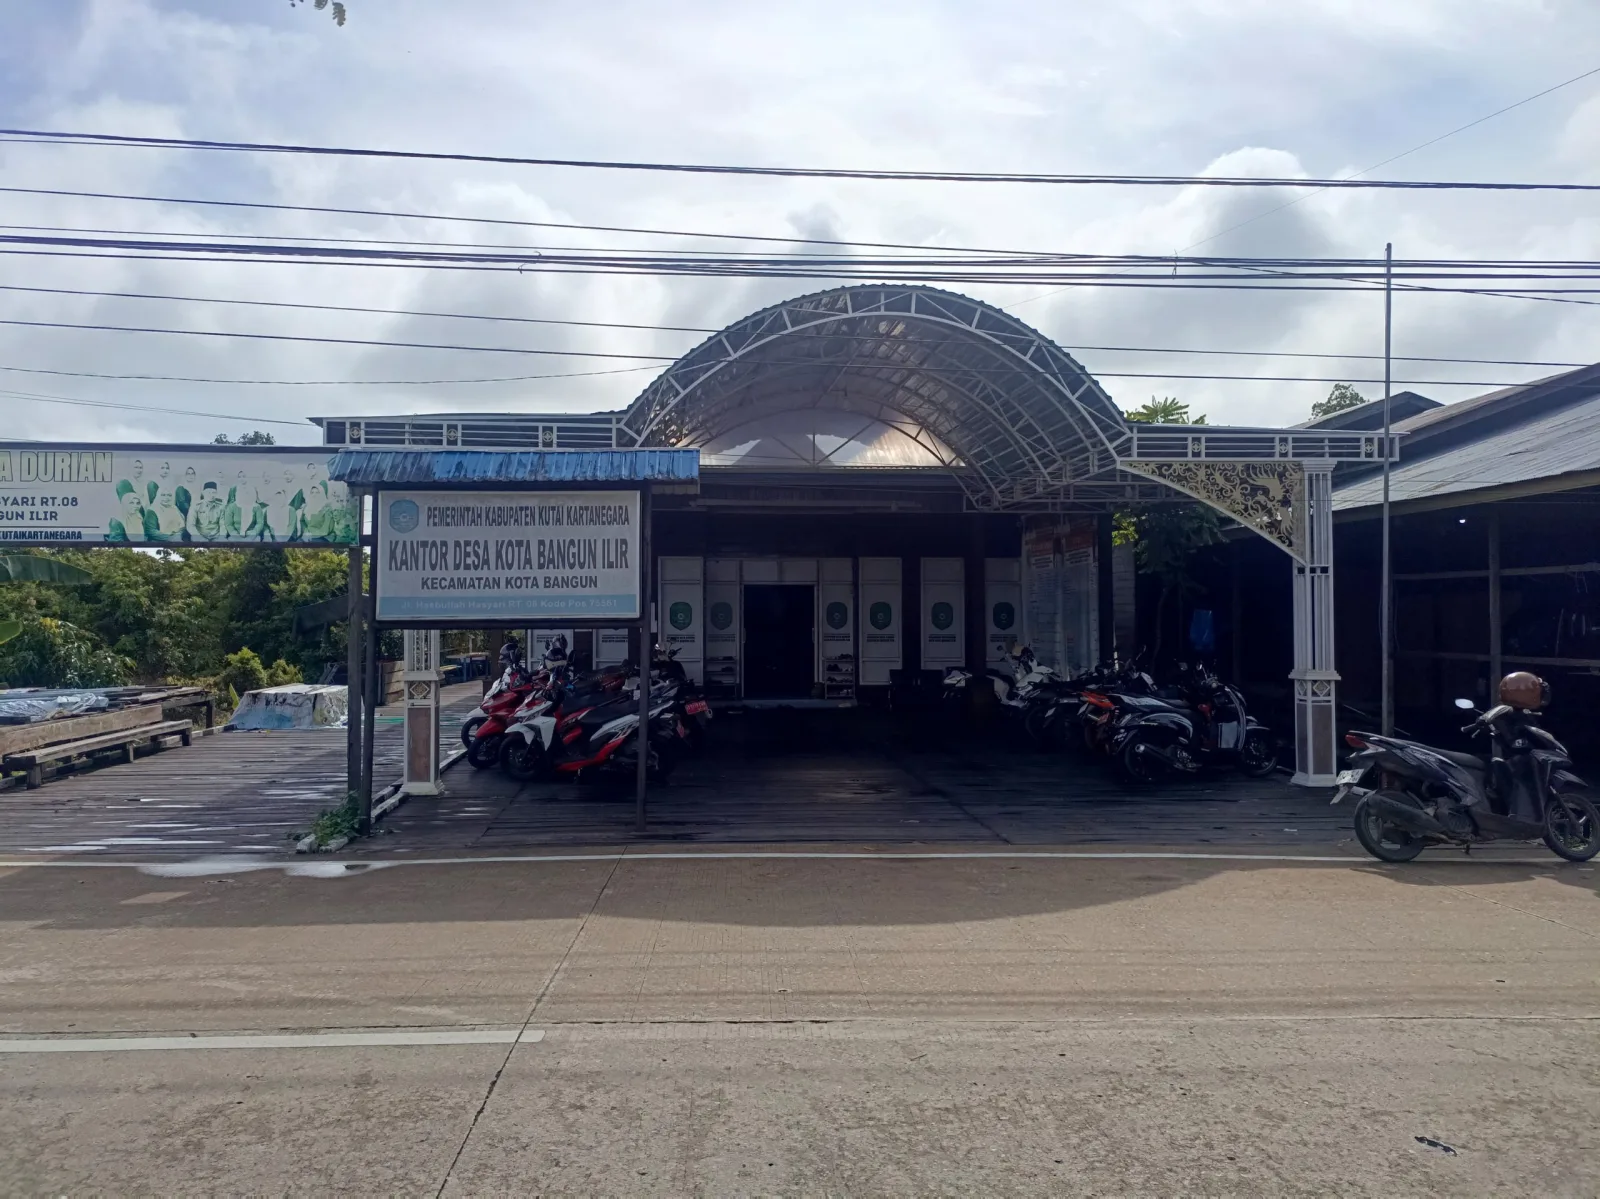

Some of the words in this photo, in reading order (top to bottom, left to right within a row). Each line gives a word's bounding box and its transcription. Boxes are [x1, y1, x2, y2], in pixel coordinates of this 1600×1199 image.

[20, 451, 113, 482] DURIAN
[0, 496, 36, 507] YARI
[40, 496, 78, 507] RT.08
[29, 511, 58, 521] ILIR
[426, 506, 482, 527] PEMERINTAH
[485, 506, 536, 527] KABUPATEN
[538, 506, 564, 526] KUTAI
[566, 505, 630, 526] KARTANEGARA
[0, 530, 82, 540] UTAIKARTANEGARA
[388, 540, 449, 571] KANTOR
[453, 539, 491, 571] DESA
[495, 539, 533, 571] KOTA
[537, 539, 597, 570] BANGUN
[602, 538, 629, 569] ILIR
[420, 577, 501, 590] KECAMATAN
[505, 576, 540, 589] KOTA
[543, 576, 598, 589] BANGUN
[540, 599, 566, 608] Kode
[568, 599, 587, 608] Pos
